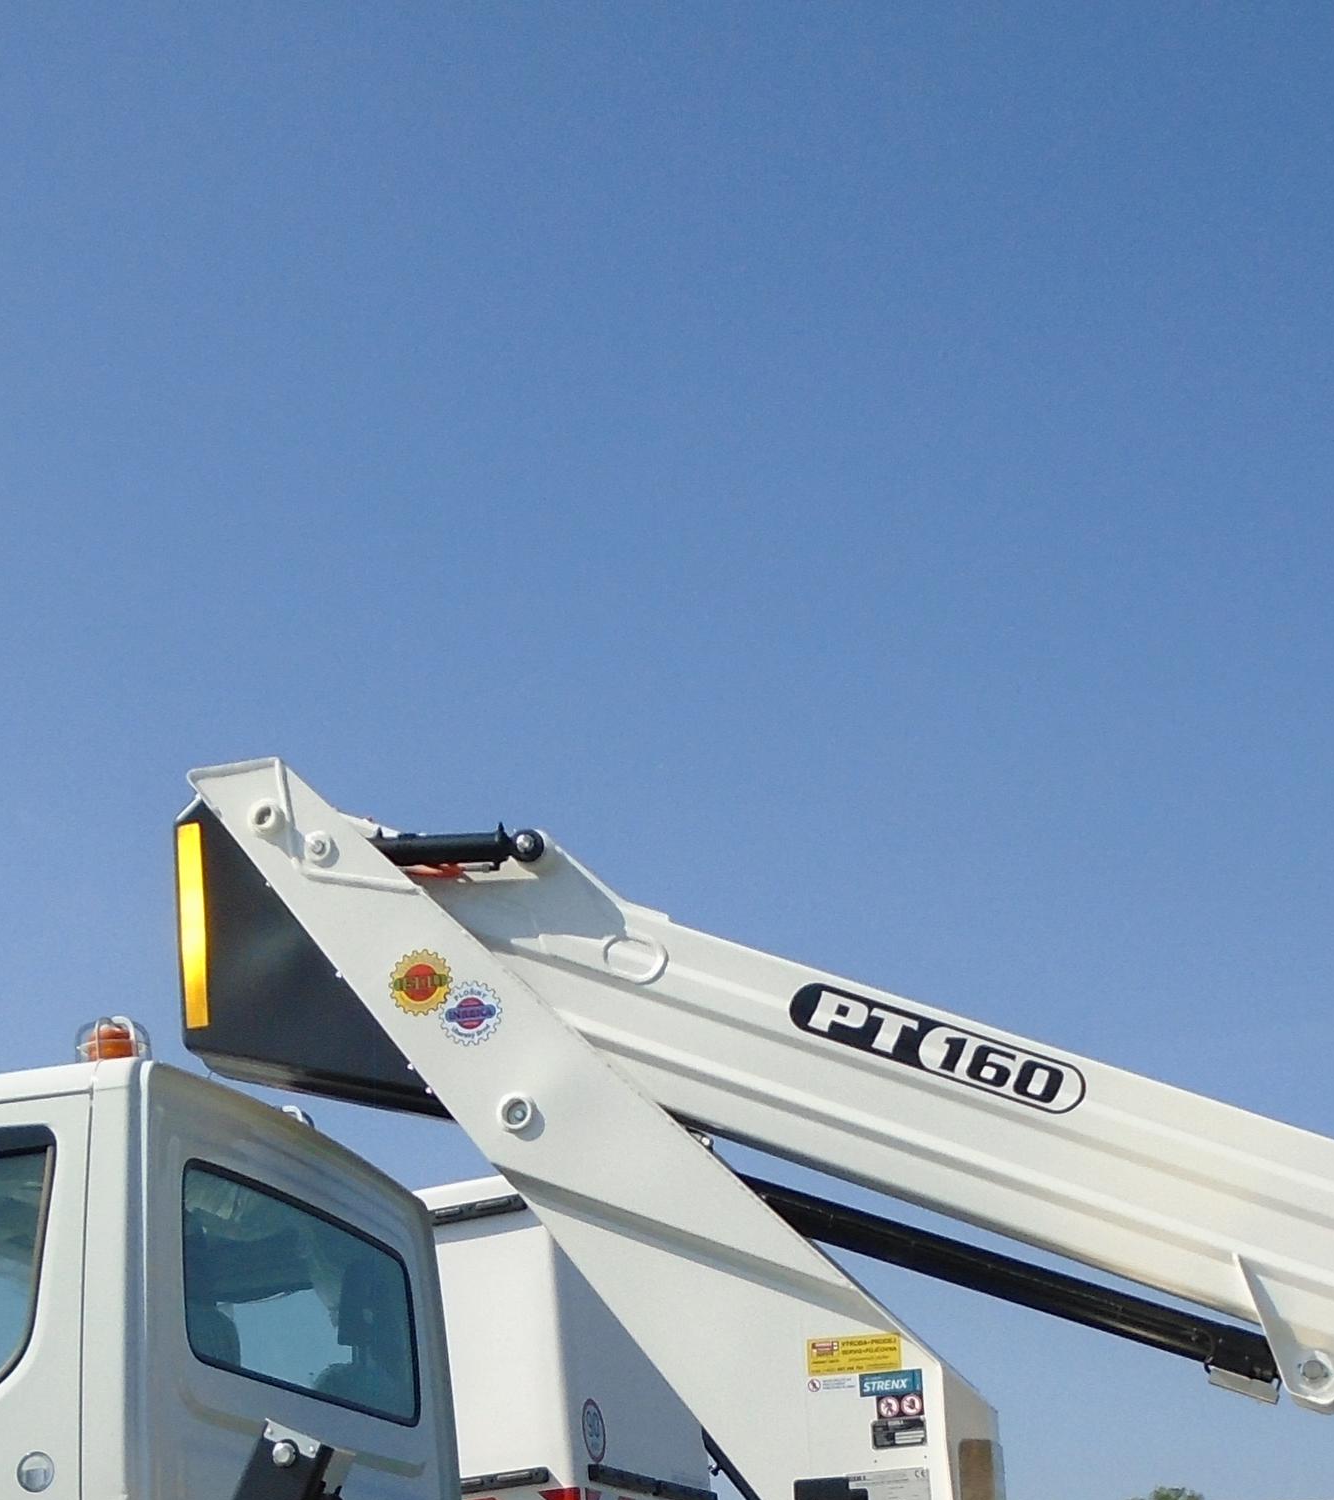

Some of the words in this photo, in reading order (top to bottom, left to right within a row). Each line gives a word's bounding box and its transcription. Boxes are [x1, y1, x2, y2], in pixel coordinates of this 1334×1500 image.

[808, 990, 919, 1054] PT
[937, 1036, 1065, 1103] 160
[863, 1379, 907, 1392] STRENX
